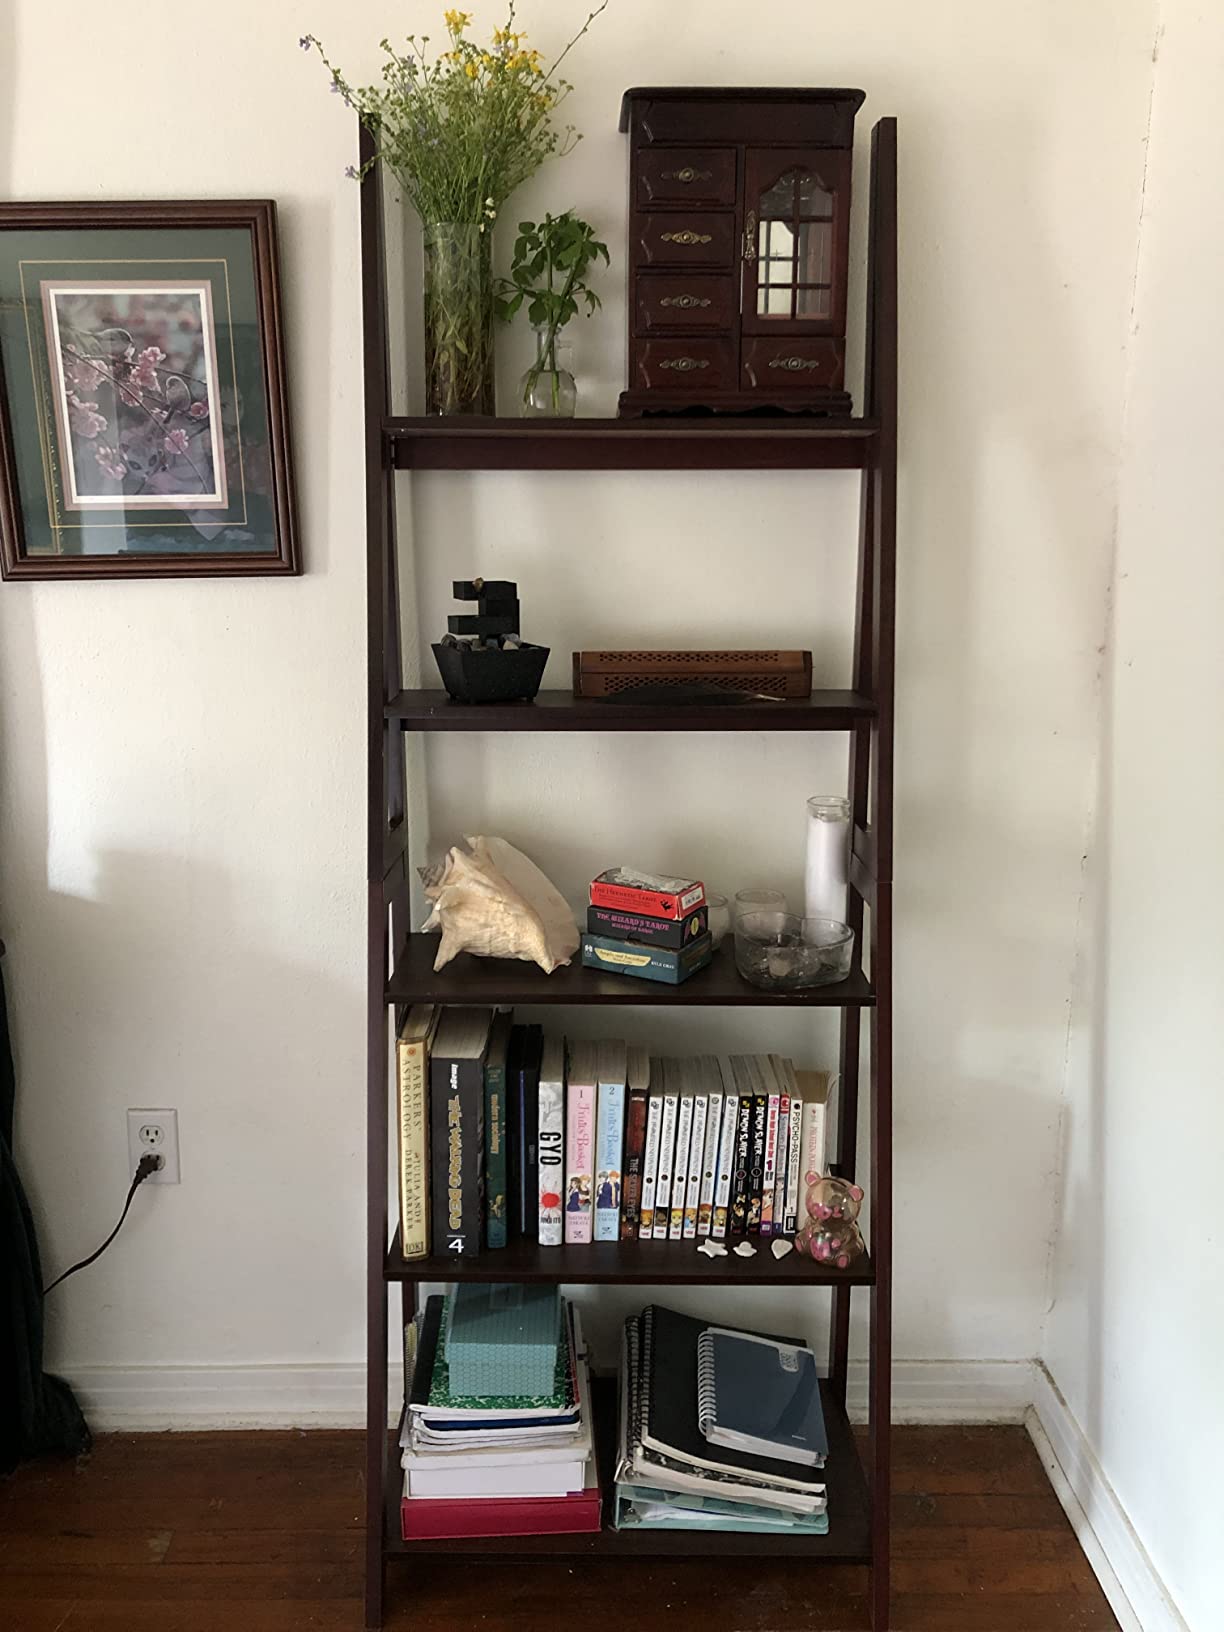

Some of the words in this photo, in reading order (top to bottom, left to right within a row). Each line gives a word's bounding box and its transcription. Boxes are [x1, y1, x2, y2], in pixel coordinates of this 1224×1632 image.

[645, 920, 670, 931] TAROT
[402, 1058, 411, 1141] ASTROLOGY
[412, 1063, 423, 1132] PARKERS'
[579, 1090, 584, 1099] 1
[609, 1087, 615, 1096] 2
[447, 1094, 462, 1128] THE
[490, 1093, 499, 1120] modern
[577, 1102, 590, 1134] Fruits
[739, 1108, 749, 1133] DEMON
[755, 1106, 765, 1130] DEMON
[489, 1122, 500, 1155] sociology
[539, 1131, 562, 1166] GYO
[576, 1133, 590, 1170] Basket
[605, 1130, 618, 1166] Basket
[738, 1133, 748, 1158] SLAYER
[754, 1130, 763, 1156] SLAYER
[790, 1111, 800, 1163] PSYCHO-PASS
[405, 1149, 413, 1185] DEREK
[448, 1127, 462, 1188] WALKING
[629, 1158, 639, 1173] THE
[628, 1173, 638, 1198] SILVER
[406, 1189, 414, 1231] PARKER
[448, 1188, 462, 1230] DEAD
[627, 1198, 637, 1218] EYES
[407, 1242, 423, 1253] DK
[448, 1238, 464, 1254] 4
